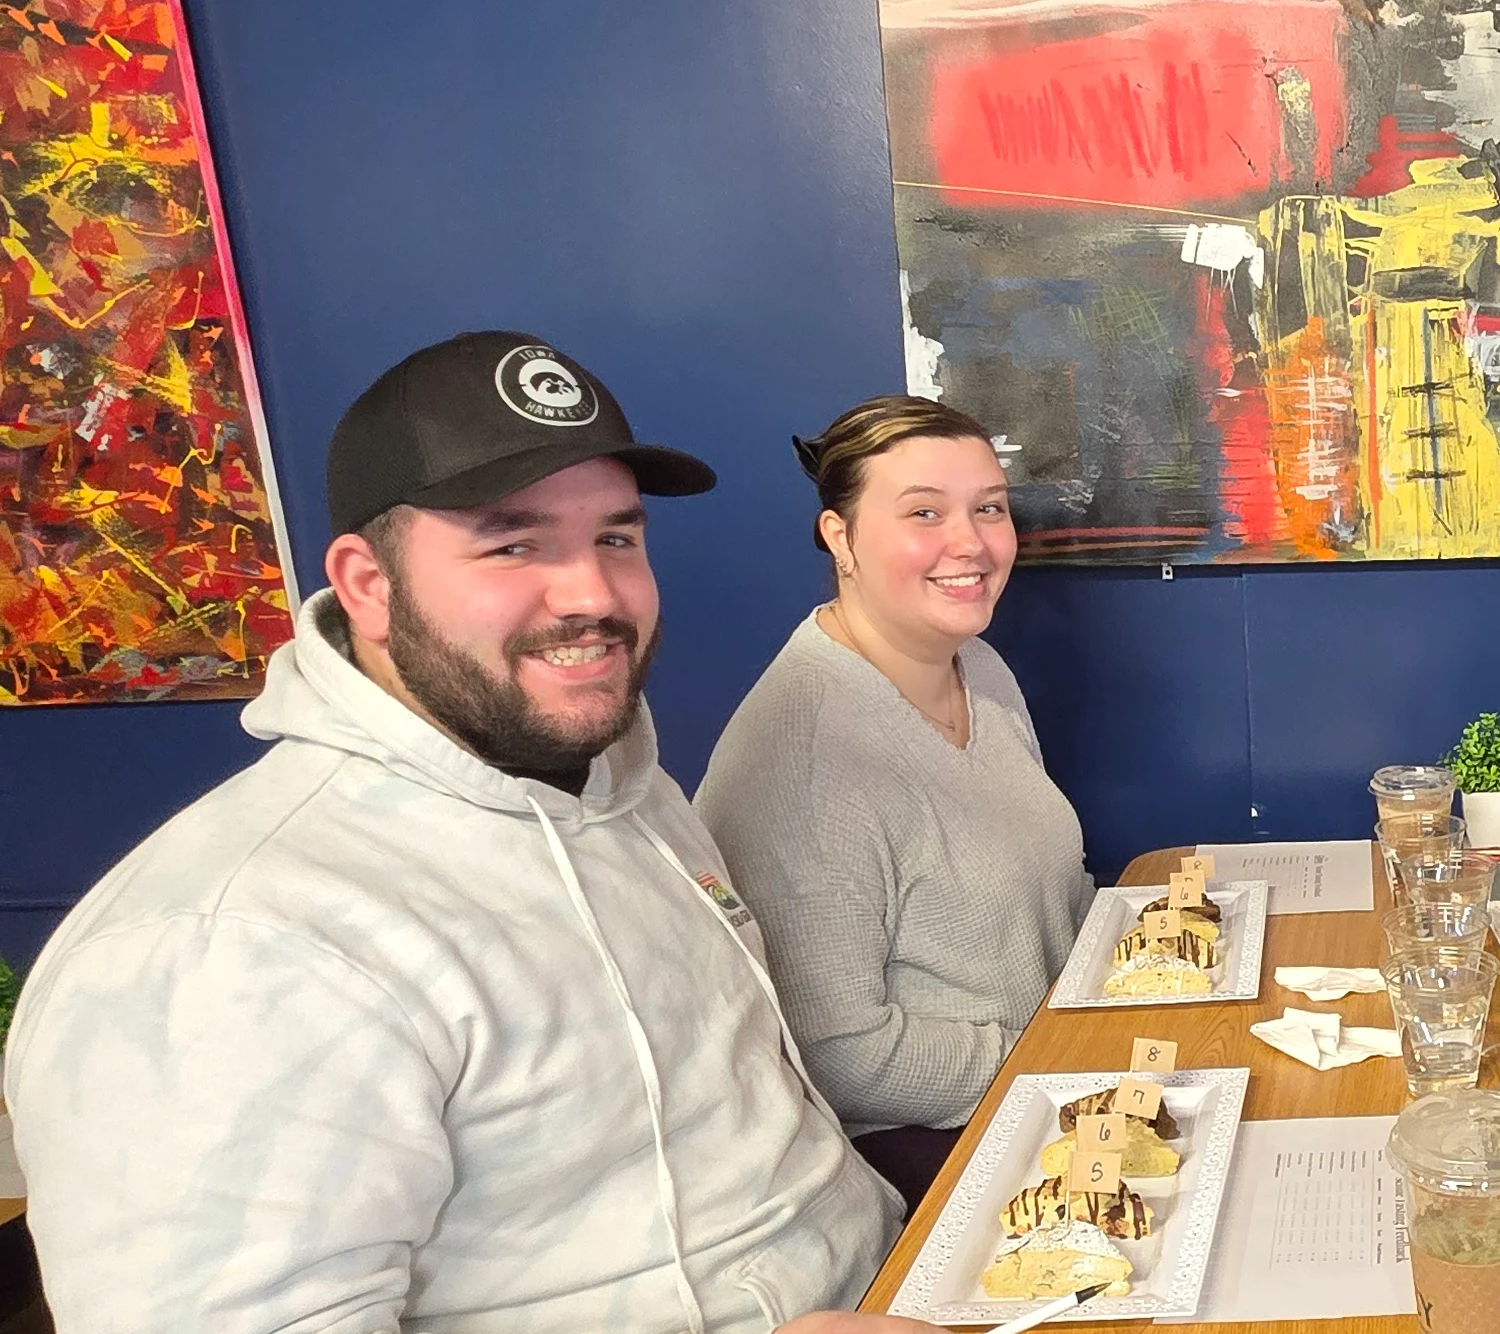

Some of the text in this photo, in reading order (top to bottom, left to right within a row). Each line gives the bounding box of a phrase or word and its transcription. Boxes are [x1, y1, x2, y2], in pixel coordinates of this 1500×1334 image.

[519, 349, 556, 360] IOWA
[1180, 886, 1189, 900] 6
[1160, 915, 1168, 930] 5
[1147, 1046, 1161, 1062] 8
[1132, 1089, 1145, 1105] 7
[1099, 1122, 1111, 1141] 6
[1090, 1161, 1104, 1183] 5
